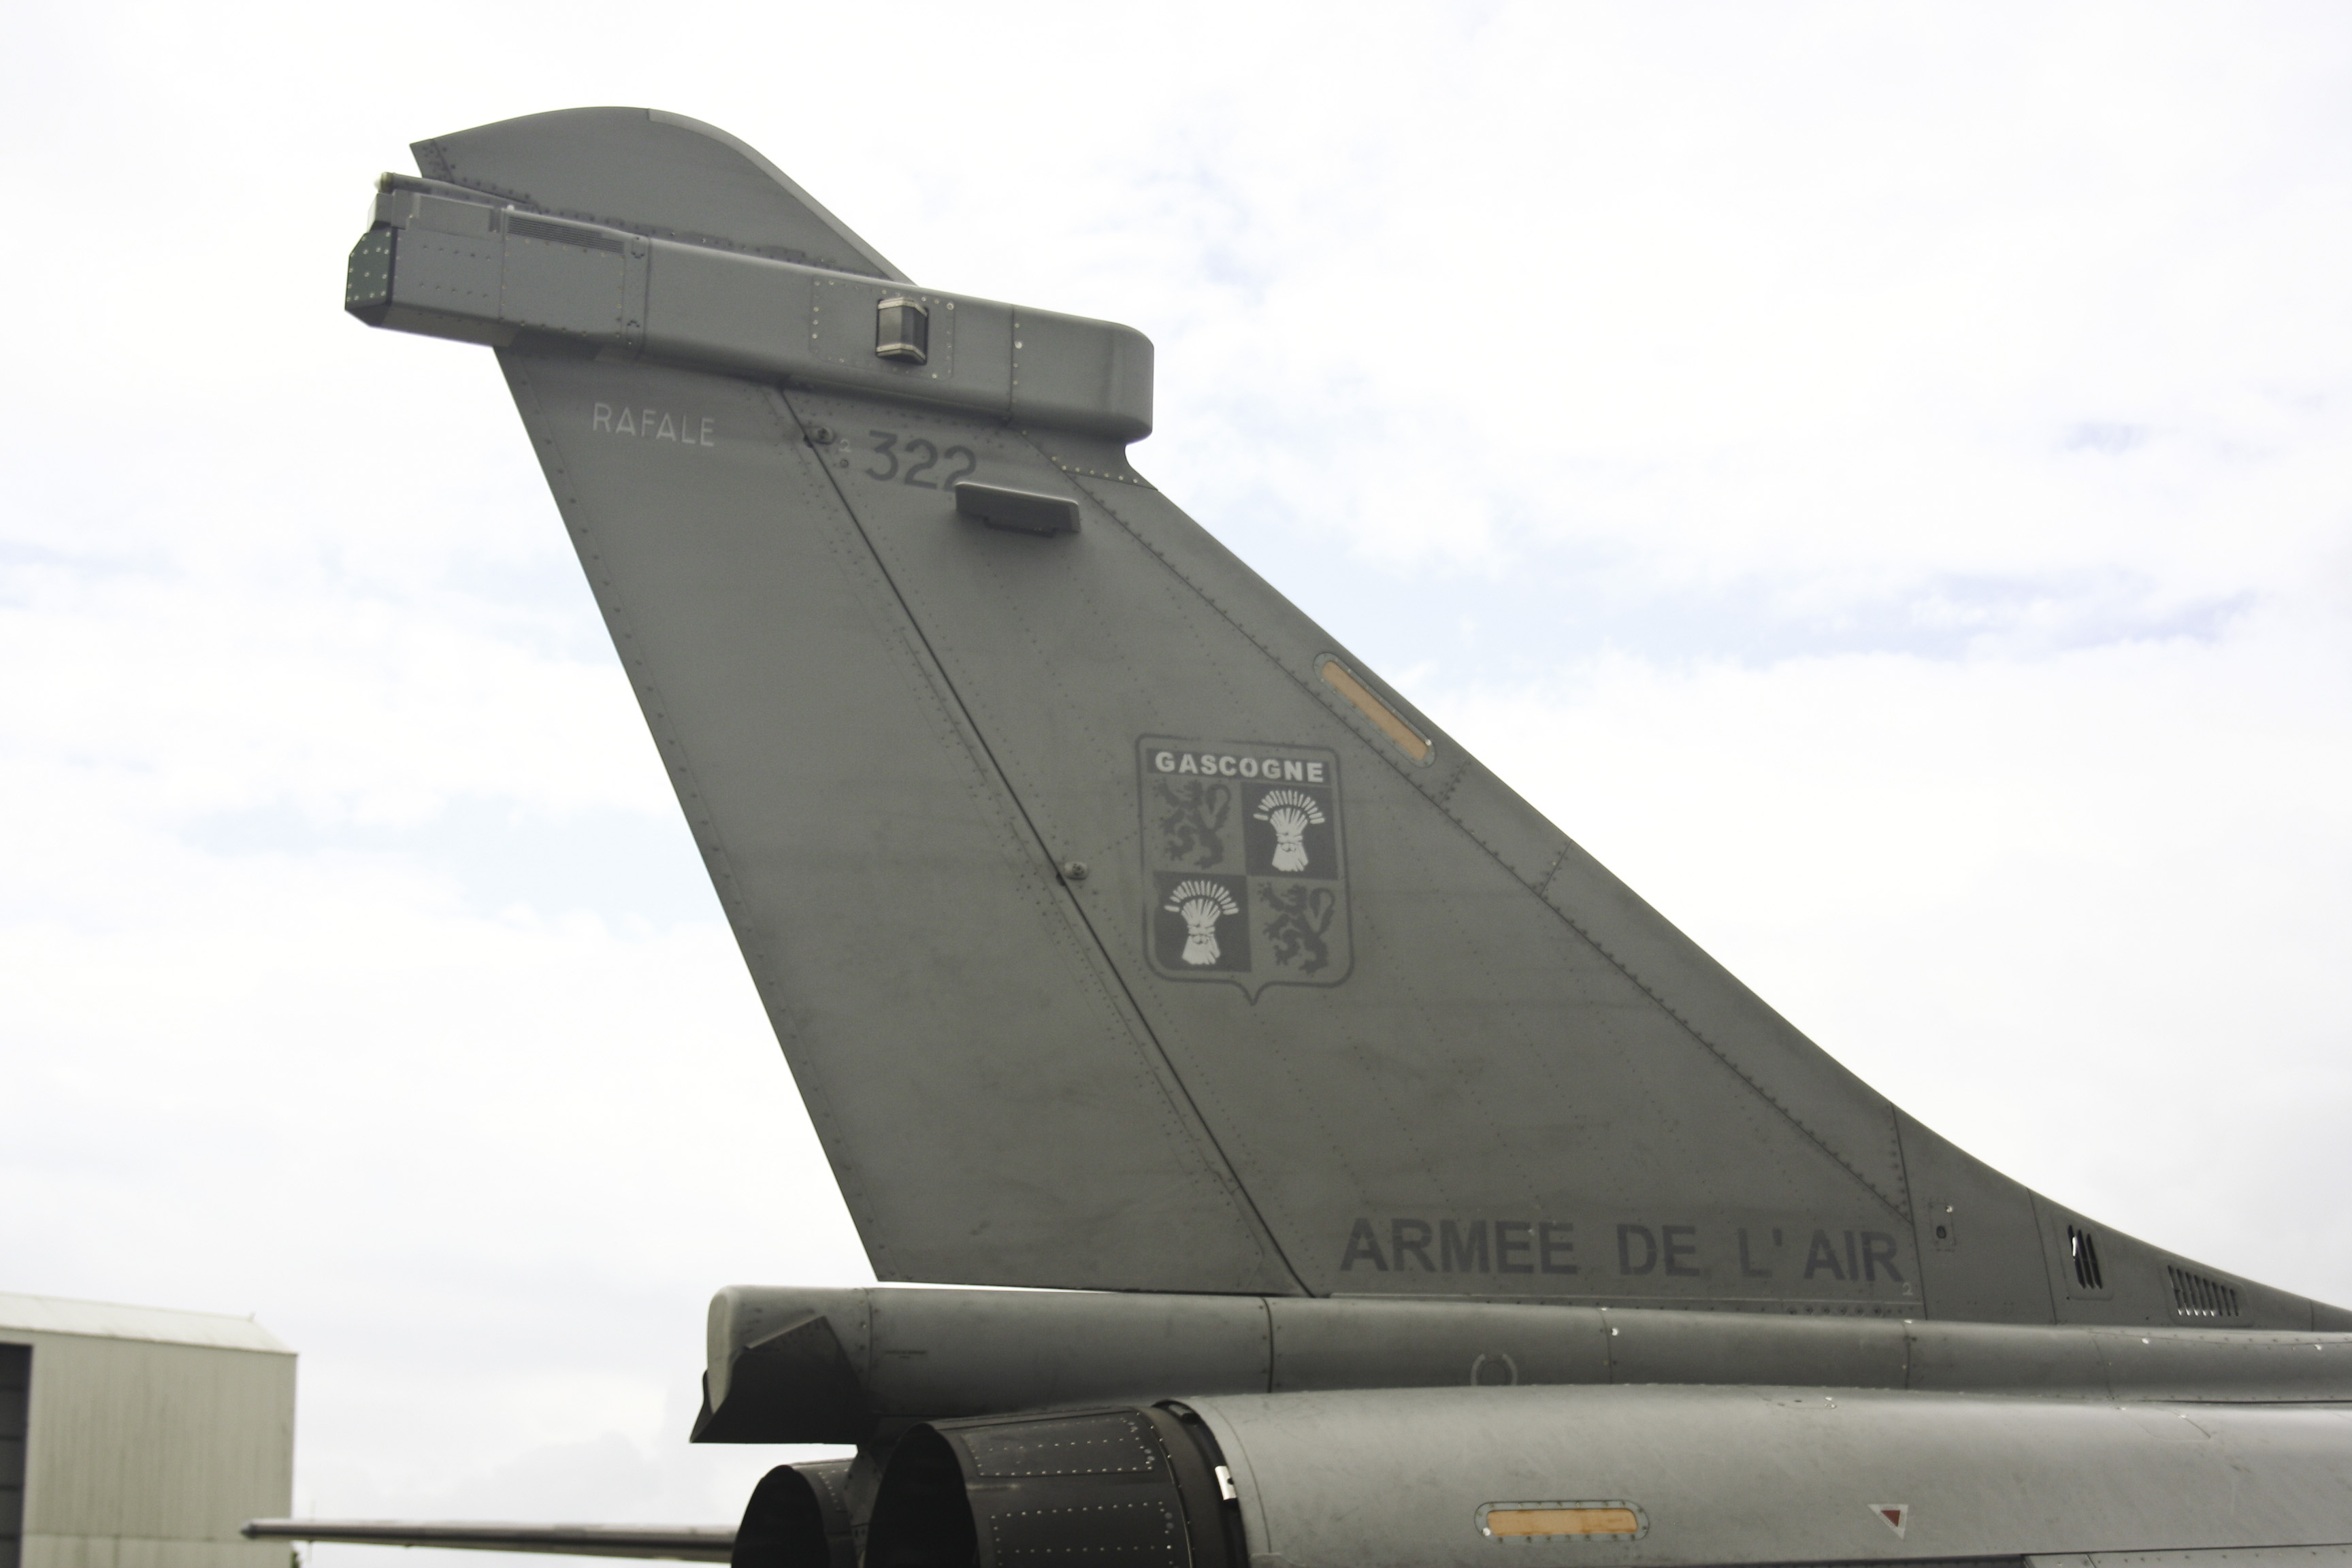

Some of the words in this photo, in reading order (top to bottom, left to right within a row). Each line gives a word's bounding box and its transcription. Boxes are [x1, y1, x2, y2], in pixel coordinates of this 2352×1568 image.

[592, 402, 715, 446] RAFALE
[864, 429, 977, 492] 322
[1155, 751, 1324, 783] GASCOGNE
[1339, 1218, 1578, 1276] ARMEE
[1616, 1224, 1700, 1277] DE
